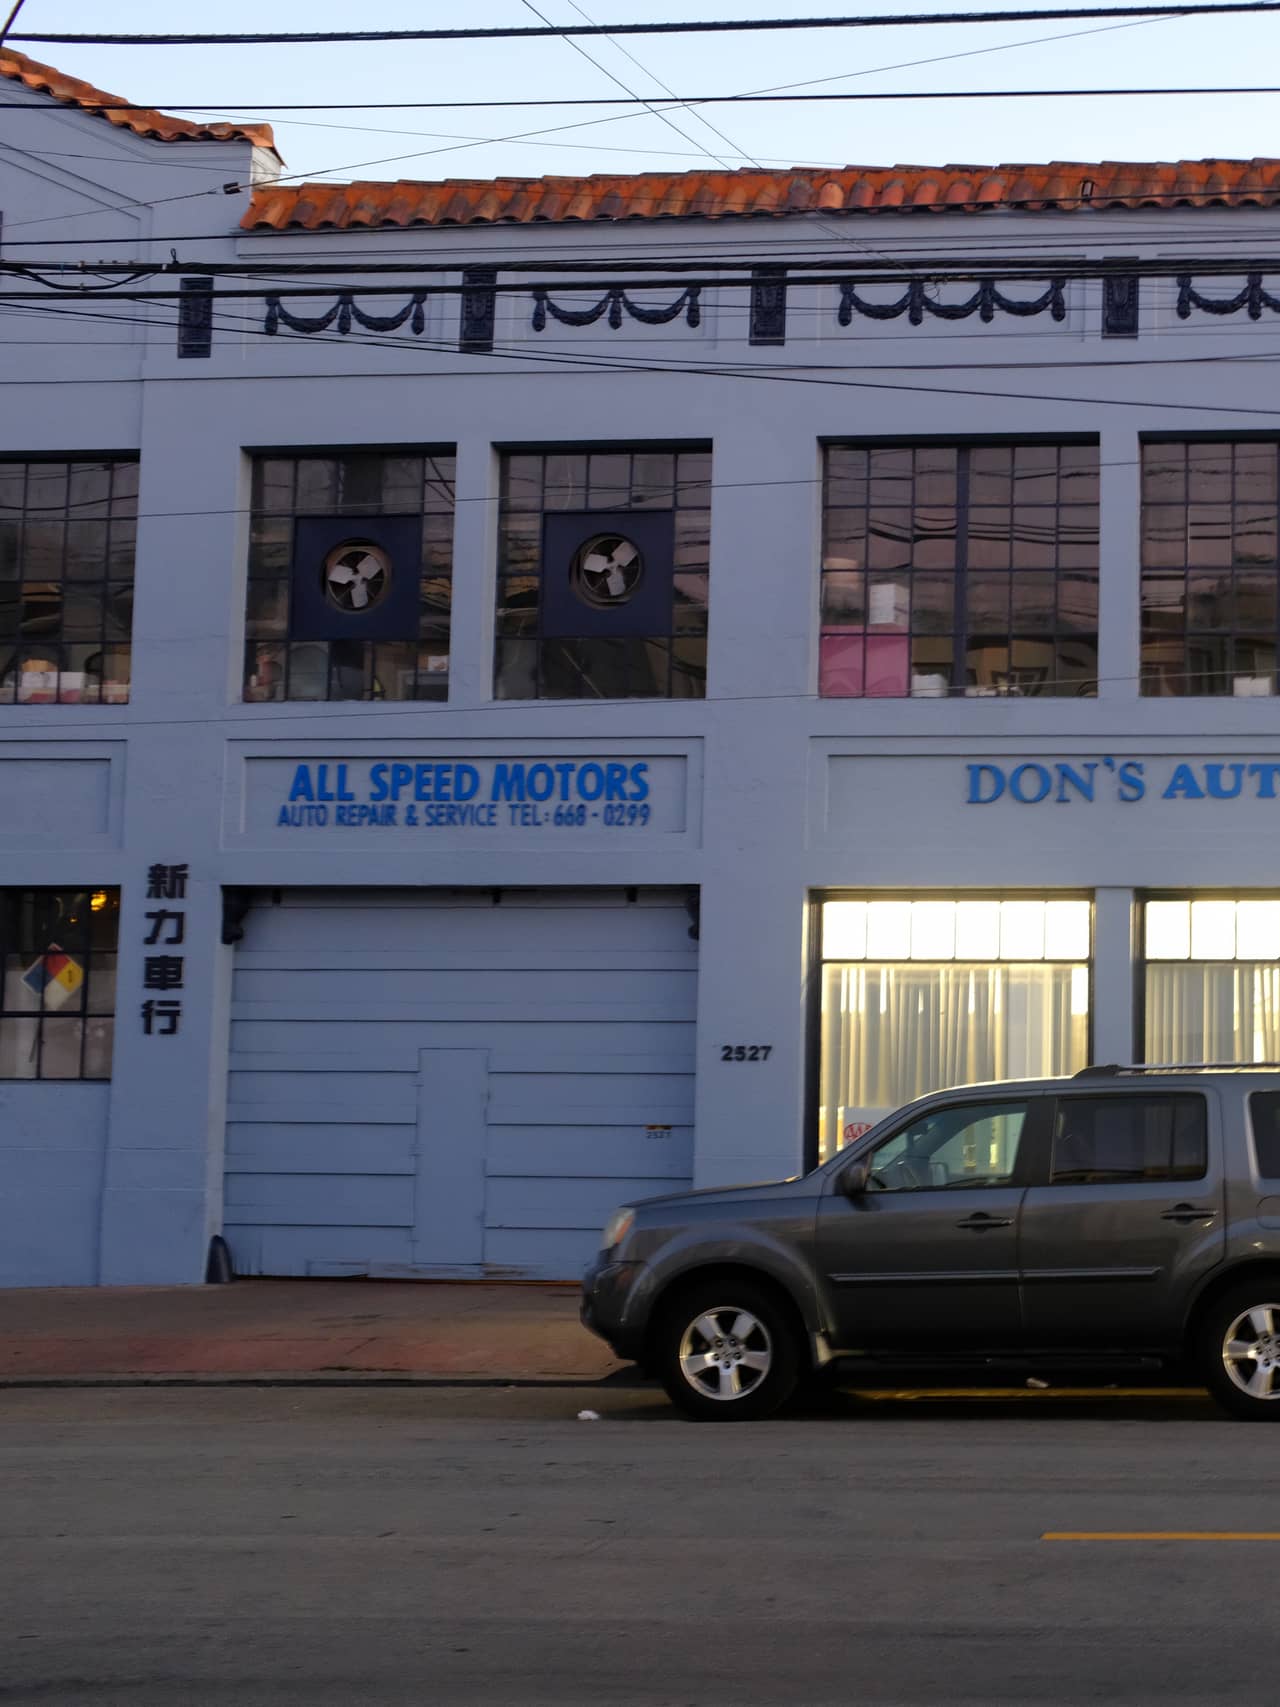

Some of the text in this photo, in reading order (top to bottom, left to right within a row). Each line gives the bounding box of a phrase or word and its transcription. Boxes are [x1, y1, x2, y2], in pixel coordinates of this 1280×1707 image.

[288, 762, 649, 801] ALL SPEED MOTORS
[966, 757, 1145, 804] DON'S
[277, 804, 328, 827] AUTO
[335, 804, 398, 827] REPAIR
[405, 804, 419, 827] &
[425, 803, 497, 827] SERVICE
[141, 864, 189, 1035] 新力車行
[721, 1045, 773, 1062] 2527
